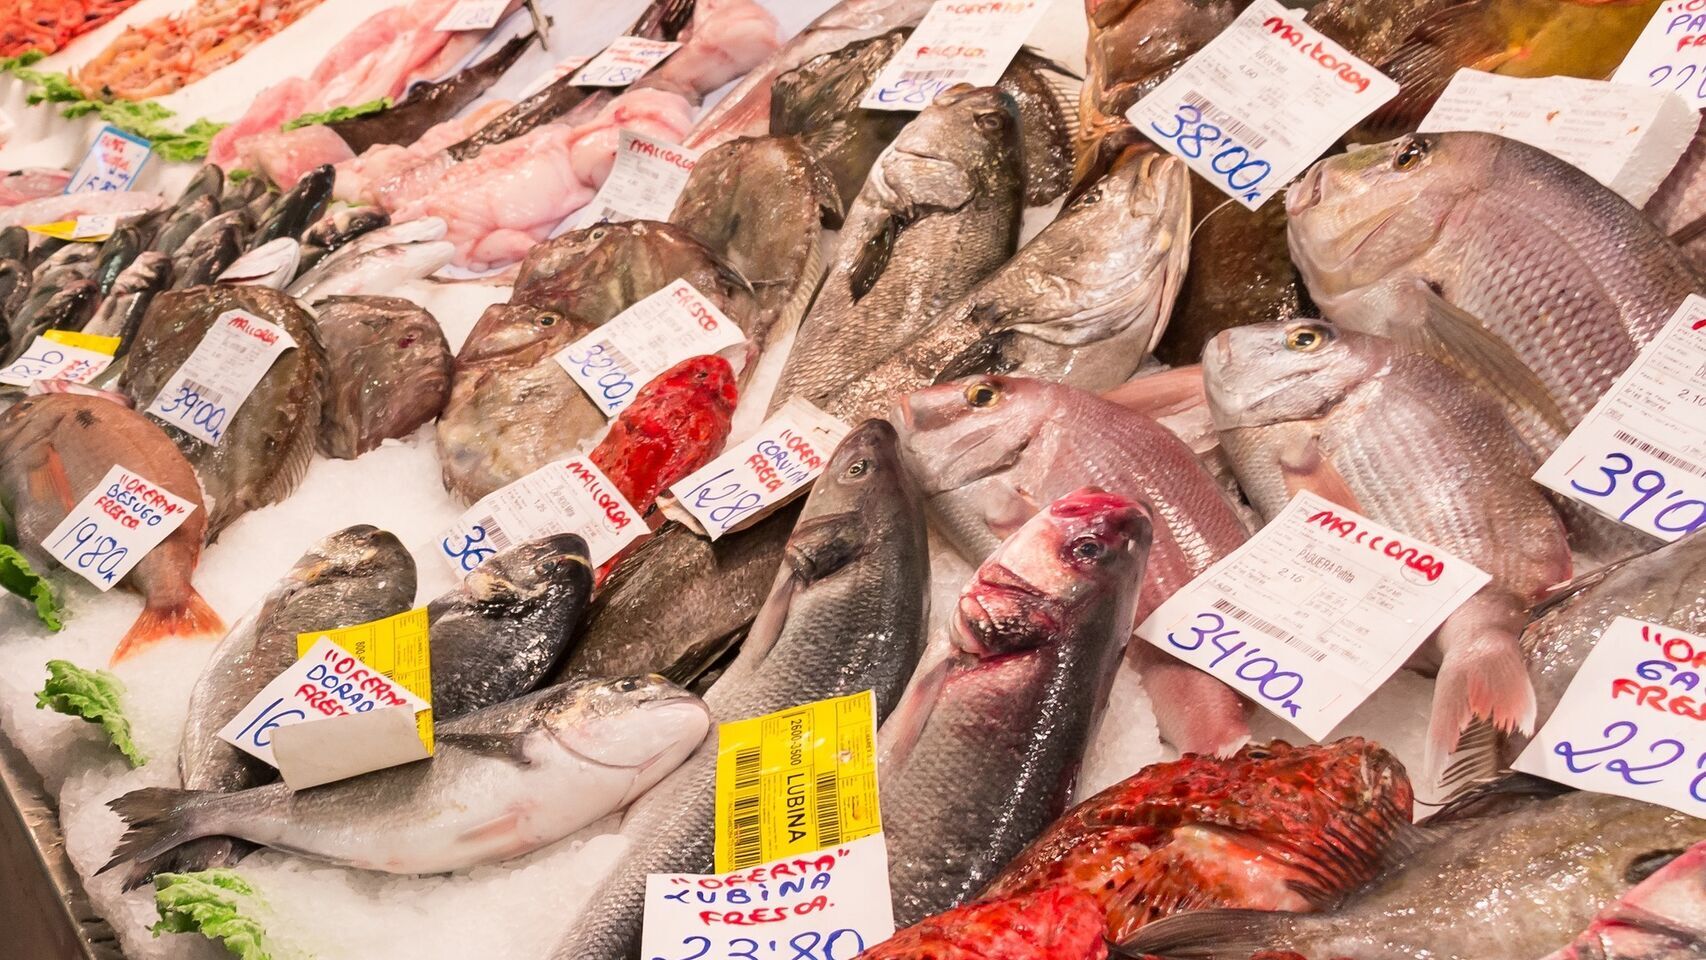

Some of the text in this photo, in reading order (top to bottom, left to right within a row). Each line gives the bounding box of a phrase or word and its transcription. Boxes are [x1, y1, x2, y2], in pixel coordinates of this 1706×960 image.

[106, 483, 162, 526] BESUGO
[295, 684, 350, 716] FRES
[787, 773, 807, 844] LUBINA
